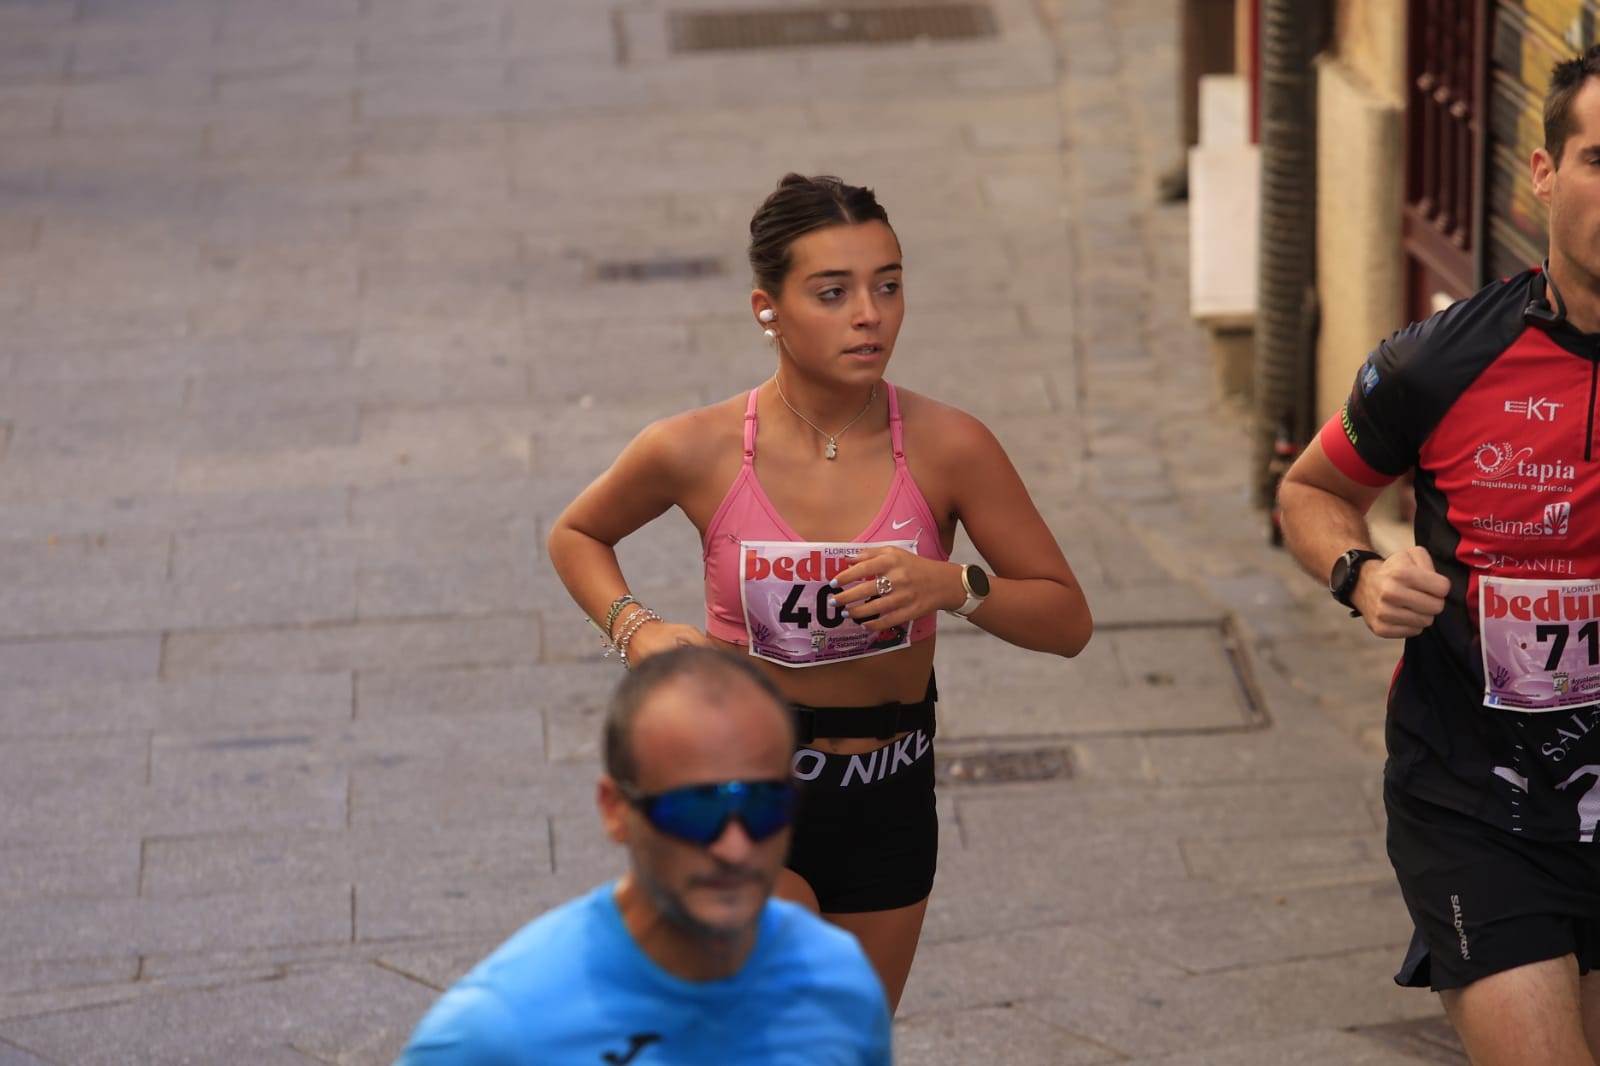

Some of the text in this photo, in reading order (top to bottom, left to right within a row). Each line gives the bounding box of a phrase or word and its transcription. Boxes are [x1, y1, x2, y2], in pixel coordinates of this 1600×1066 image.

[1504, 396, 1564, 421] EKT
[1517, 460, 1575, 483] tapia
[1471, 479, 1527, 491] maquinaria
[1472, 514, 1543, 536] adamas
[1561, 584, 1600, 593] FLORISTE
[1484, 586, 1600, 621] bedu
[1536, 621, 1600, 671] 71
[840, 729, 930, 787] NIKE
[1450, 894, 1471, 960] SALOMON
